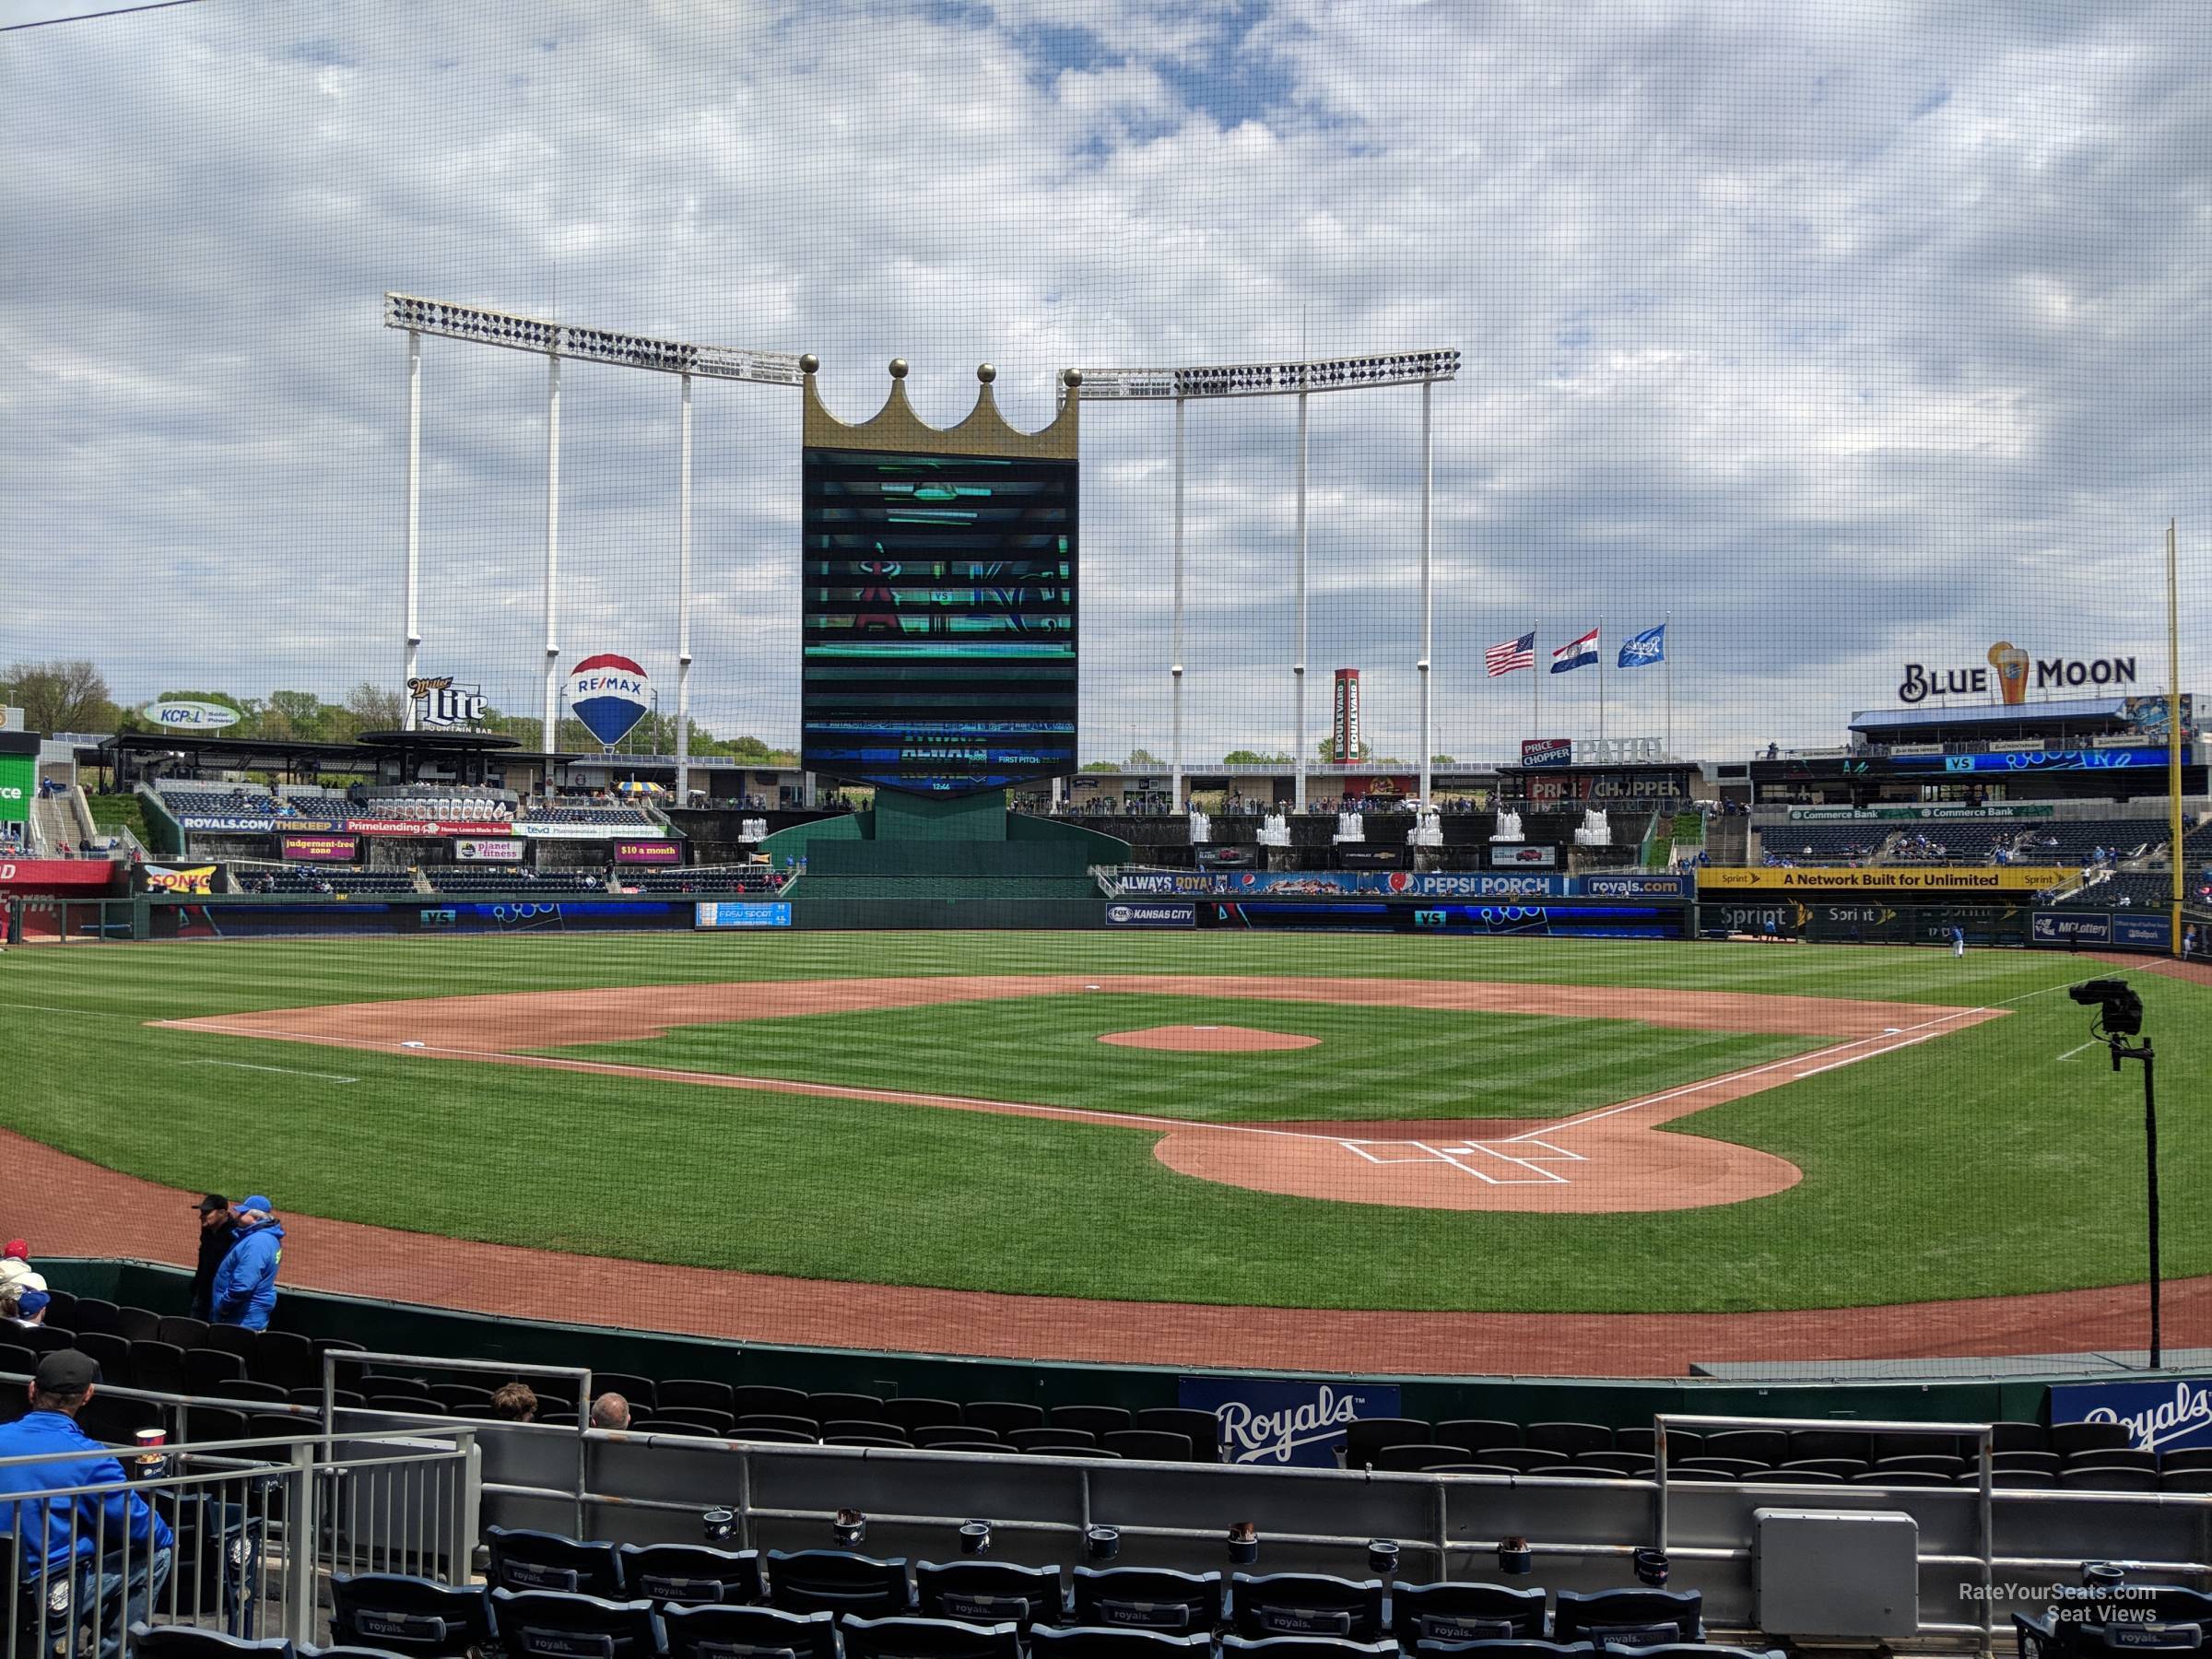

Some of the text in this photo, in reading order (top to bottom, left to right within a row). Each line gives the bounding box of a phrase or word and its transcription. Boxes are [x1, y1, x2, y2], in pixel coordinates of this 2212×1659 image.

[579, 677, 641, 695] RE/MAX
[1900, 657, 2136, 703] BLUE MOON
[407, 677, 453, 699] Miller
[424, 688, 488, 726] Lite
[161, 709, 202, 724] KCP&L
[1335, 685, 1345, 752] BOULEVARD
[426, 725, 472, 734] OUNTAIN
[1524, 740, 1553, 754] PRICE
[1577, 738, 1663, 764] PATIO
[1524, 748, 1570, 766] CHOPPER
[1951, 759, 1970, 769] VS
[0, 787, 22, 799] ce
[1804, 810, 1877, 819] Commerce Bank
[1934, 807, 2013, 818] Commerce Bank
[348, 821, 420, 833] PrimeLending
[527, 826, 550, 834] teva
[287, 840, 355, 849] judgement-free
[478, 841, 511, 852] planet
[620, 846, 637, 855] $10
[646, 846, 676, 854] month
[483, 849, 517, 857] fitness
[0, 864, 16, 879] D
[1121, 876, 1172, 889] ALWAYS
[1424, 877, 1550, 893] PEPSI PORCH
[1722, 875, 1747, 884] Sprint
[1784, 874, 1999, 885] A Network Built for Unlimited
[2025, 876, 2053, 885] Sprint
[1593, 879, 1677, 895] royals.com
[1134, 909, 1193, 920] KANSAS CITY
[1421, 912, 1442, 924] VS
[1721, 907, 1786, 929] Sprint
[1216, 1385, 1359, 1463] Royals
